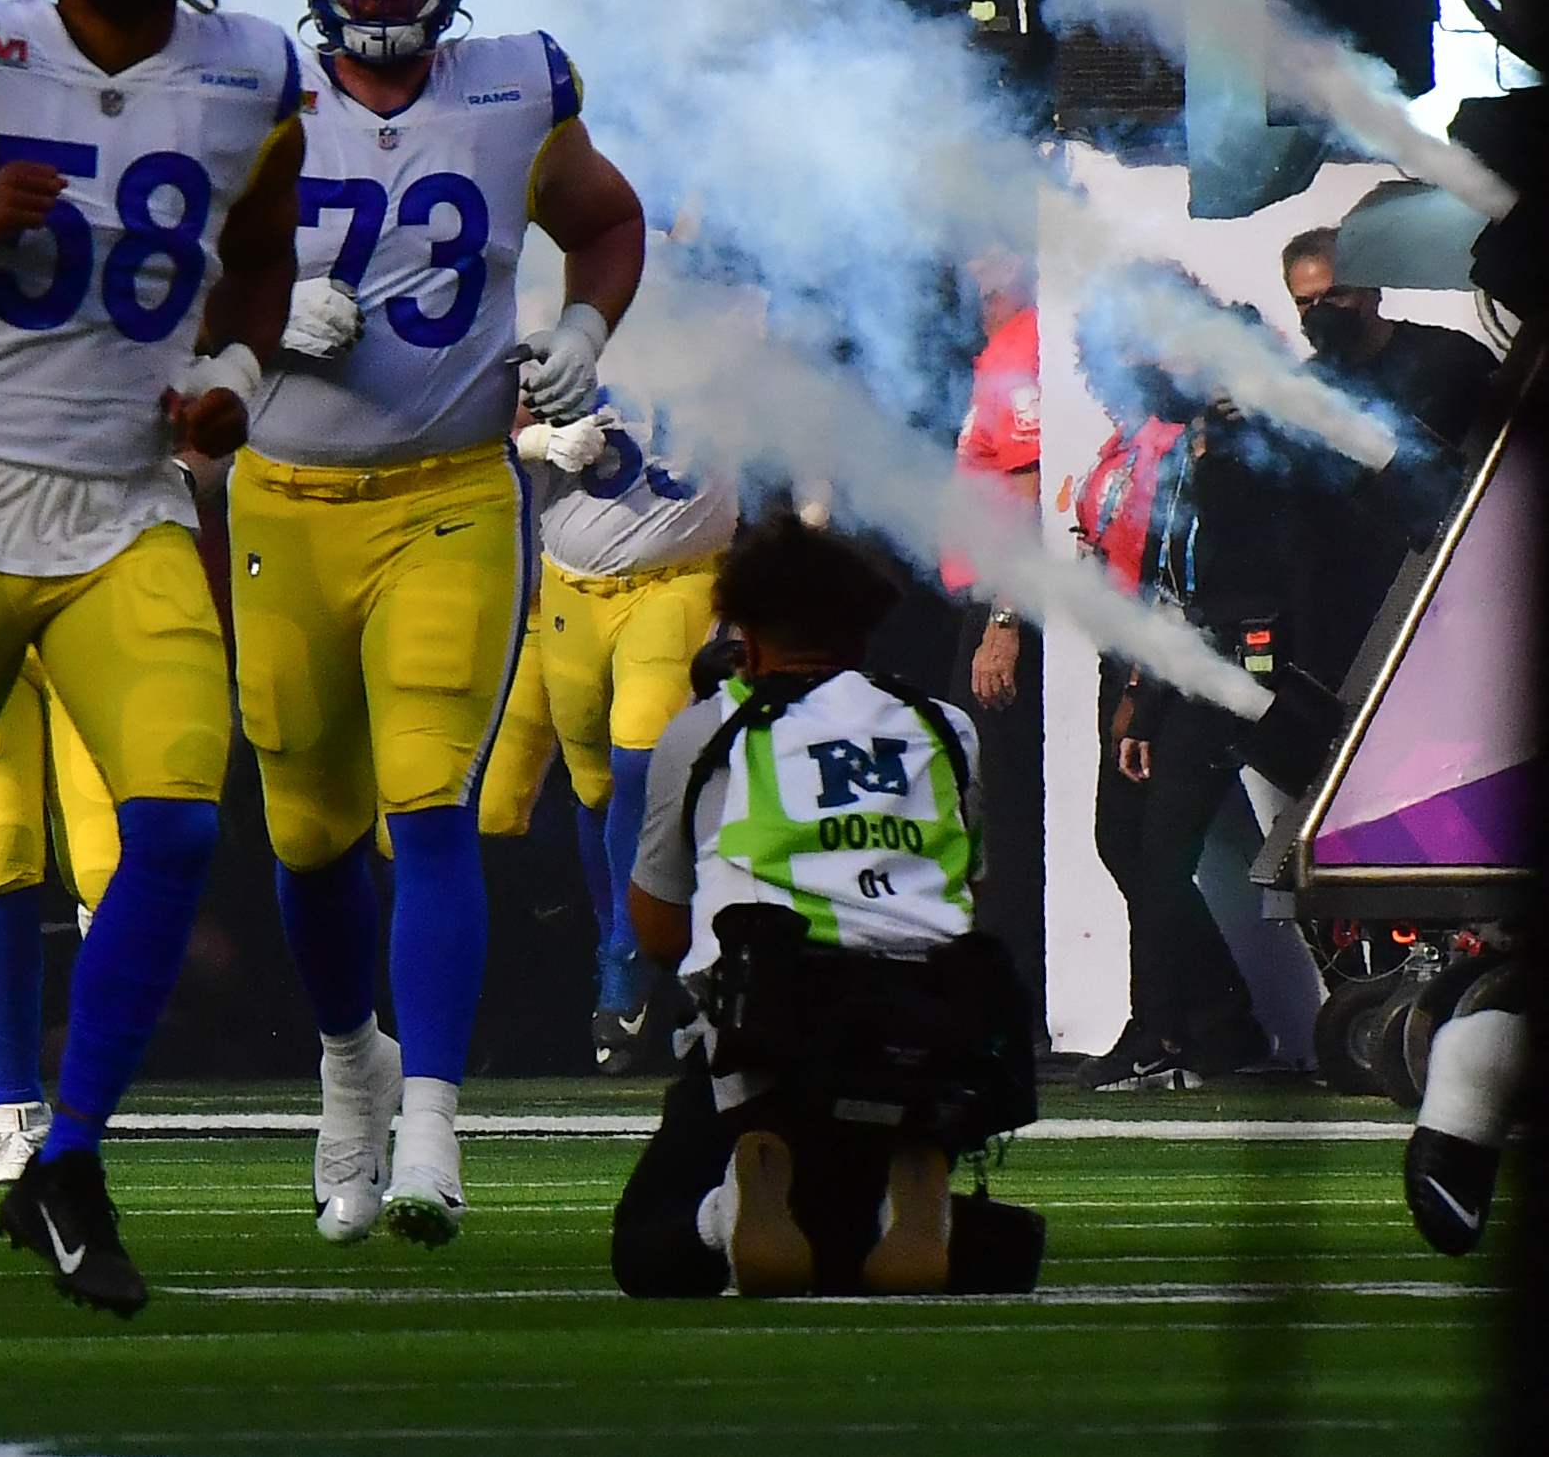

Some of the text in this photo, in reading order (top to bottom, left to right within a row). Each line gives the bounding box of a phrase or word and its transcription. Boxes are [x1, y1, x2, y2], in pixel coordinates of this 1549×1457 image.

[469, 90, 521, 104] RAMS
[295, 172, 489, 348] 73
[807, 737, 908, 808] N
[819, 814, 923, 853] 00:00
